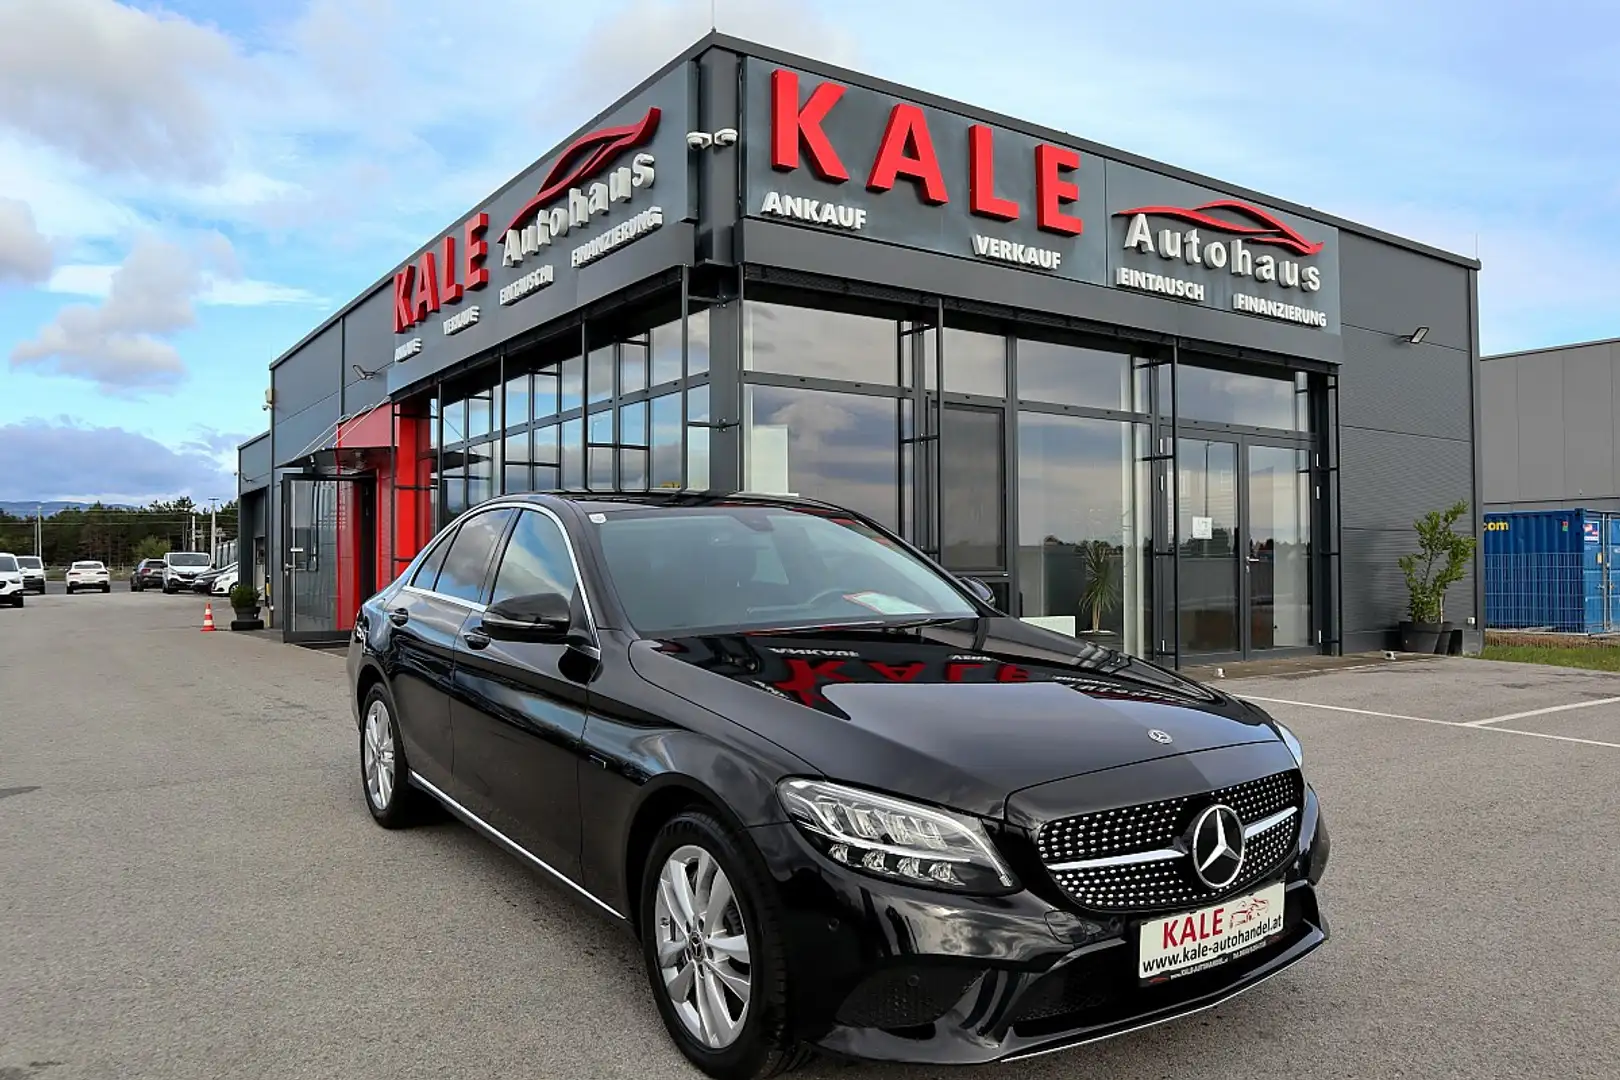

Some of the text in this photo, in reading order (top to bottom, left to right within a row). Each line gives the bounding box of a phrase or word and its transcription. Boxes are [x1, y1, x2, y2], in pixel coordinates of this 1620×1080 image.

[771, 69, 1083, 237] KALE
[503, 153, 655, 267] Autohaus
[761, 191, 866, 230] ANKAUF
[392, 212, 489, 333] KALE
[971, 234, 1061, 270] VERKAUF
[1123, 213, 1321, 292] Autohaus
[1116, 267, 1204, 301] EINTAUSCH
[1233, 293, 1327, 327] FINANZIERUNG
[1143, 914, 1281, 973] www.kale-autohandel.at
[1163, 908, 1225, 949] KALE
